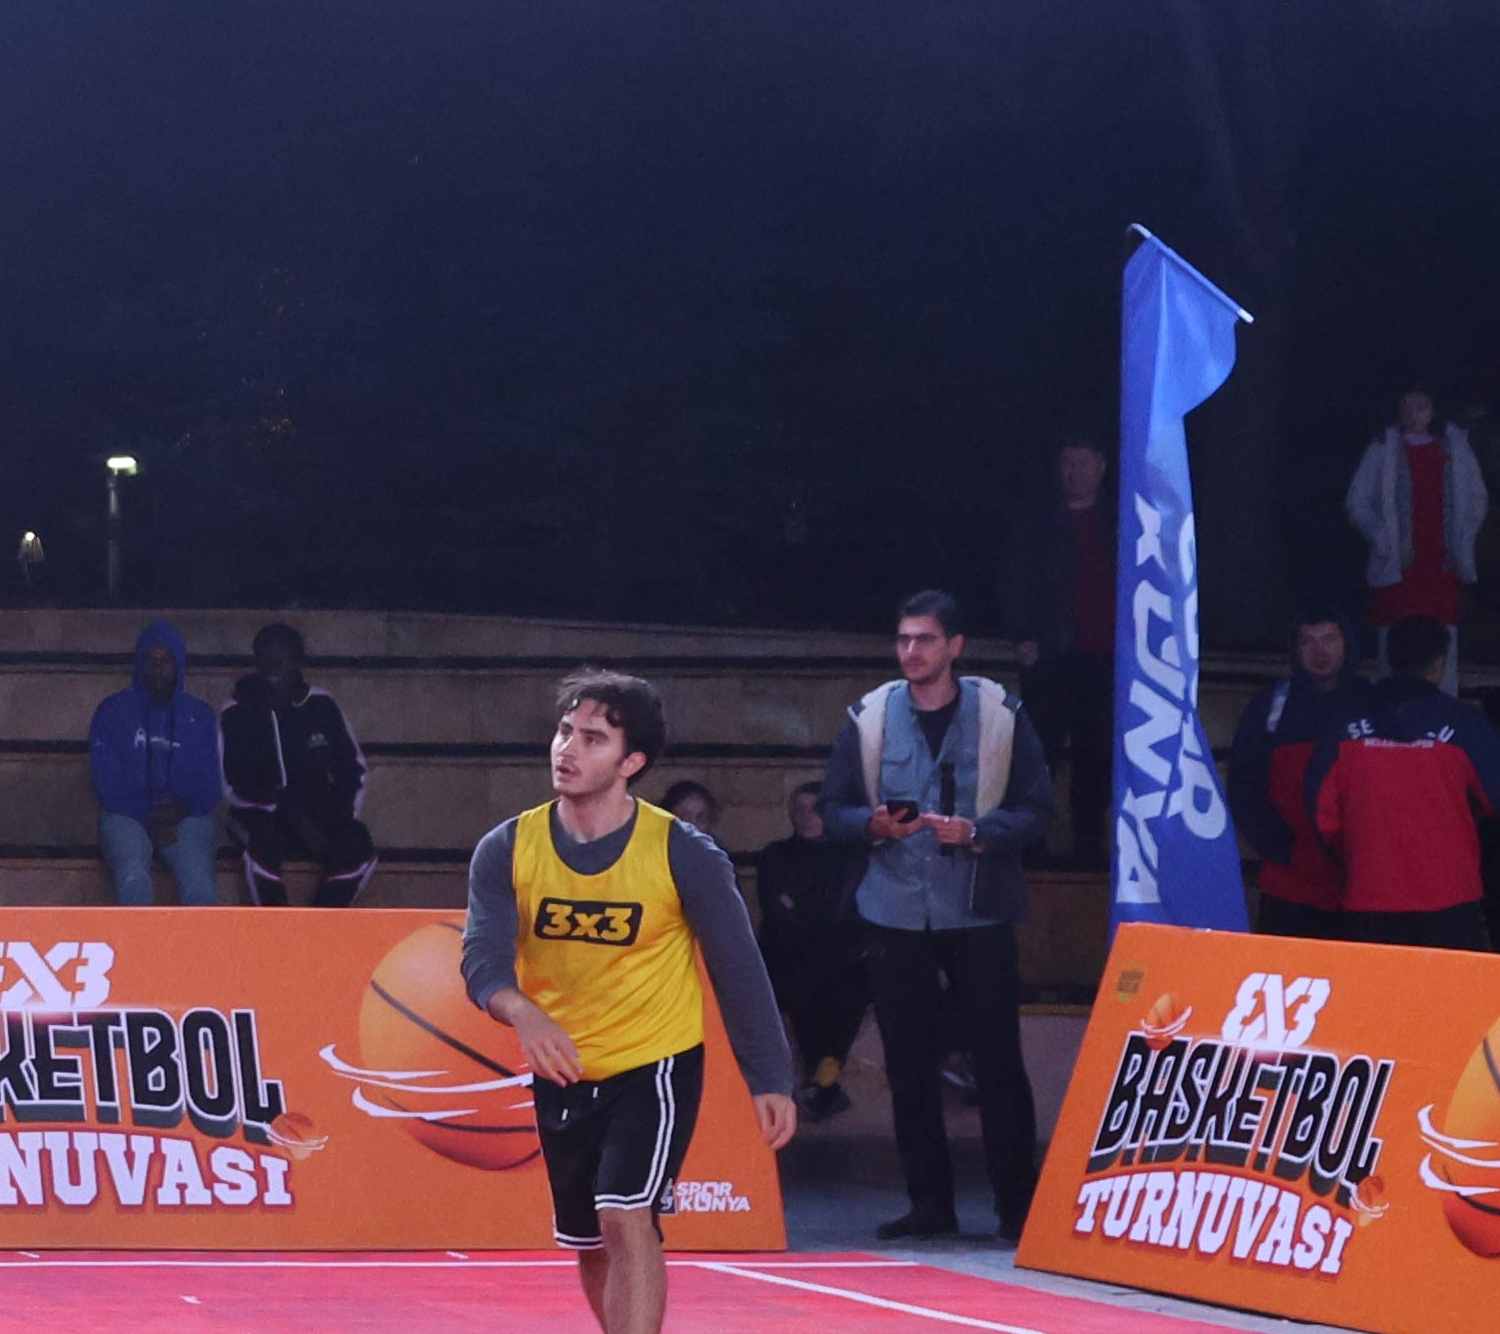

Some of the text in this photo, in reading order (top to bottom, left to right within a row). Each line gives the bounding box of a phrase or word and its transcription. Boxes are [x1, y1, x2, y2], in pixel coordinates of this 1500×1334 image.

[542, 903, 632, 941] 3x3
[1090, 1031, 1396, 1189] BASKETBOL
[676, 1182, 733, 1197] SPOR
[680, 1193, 751, 1211] KONYA
[1075, 1171, 1354, 1274] TURNUVASI
